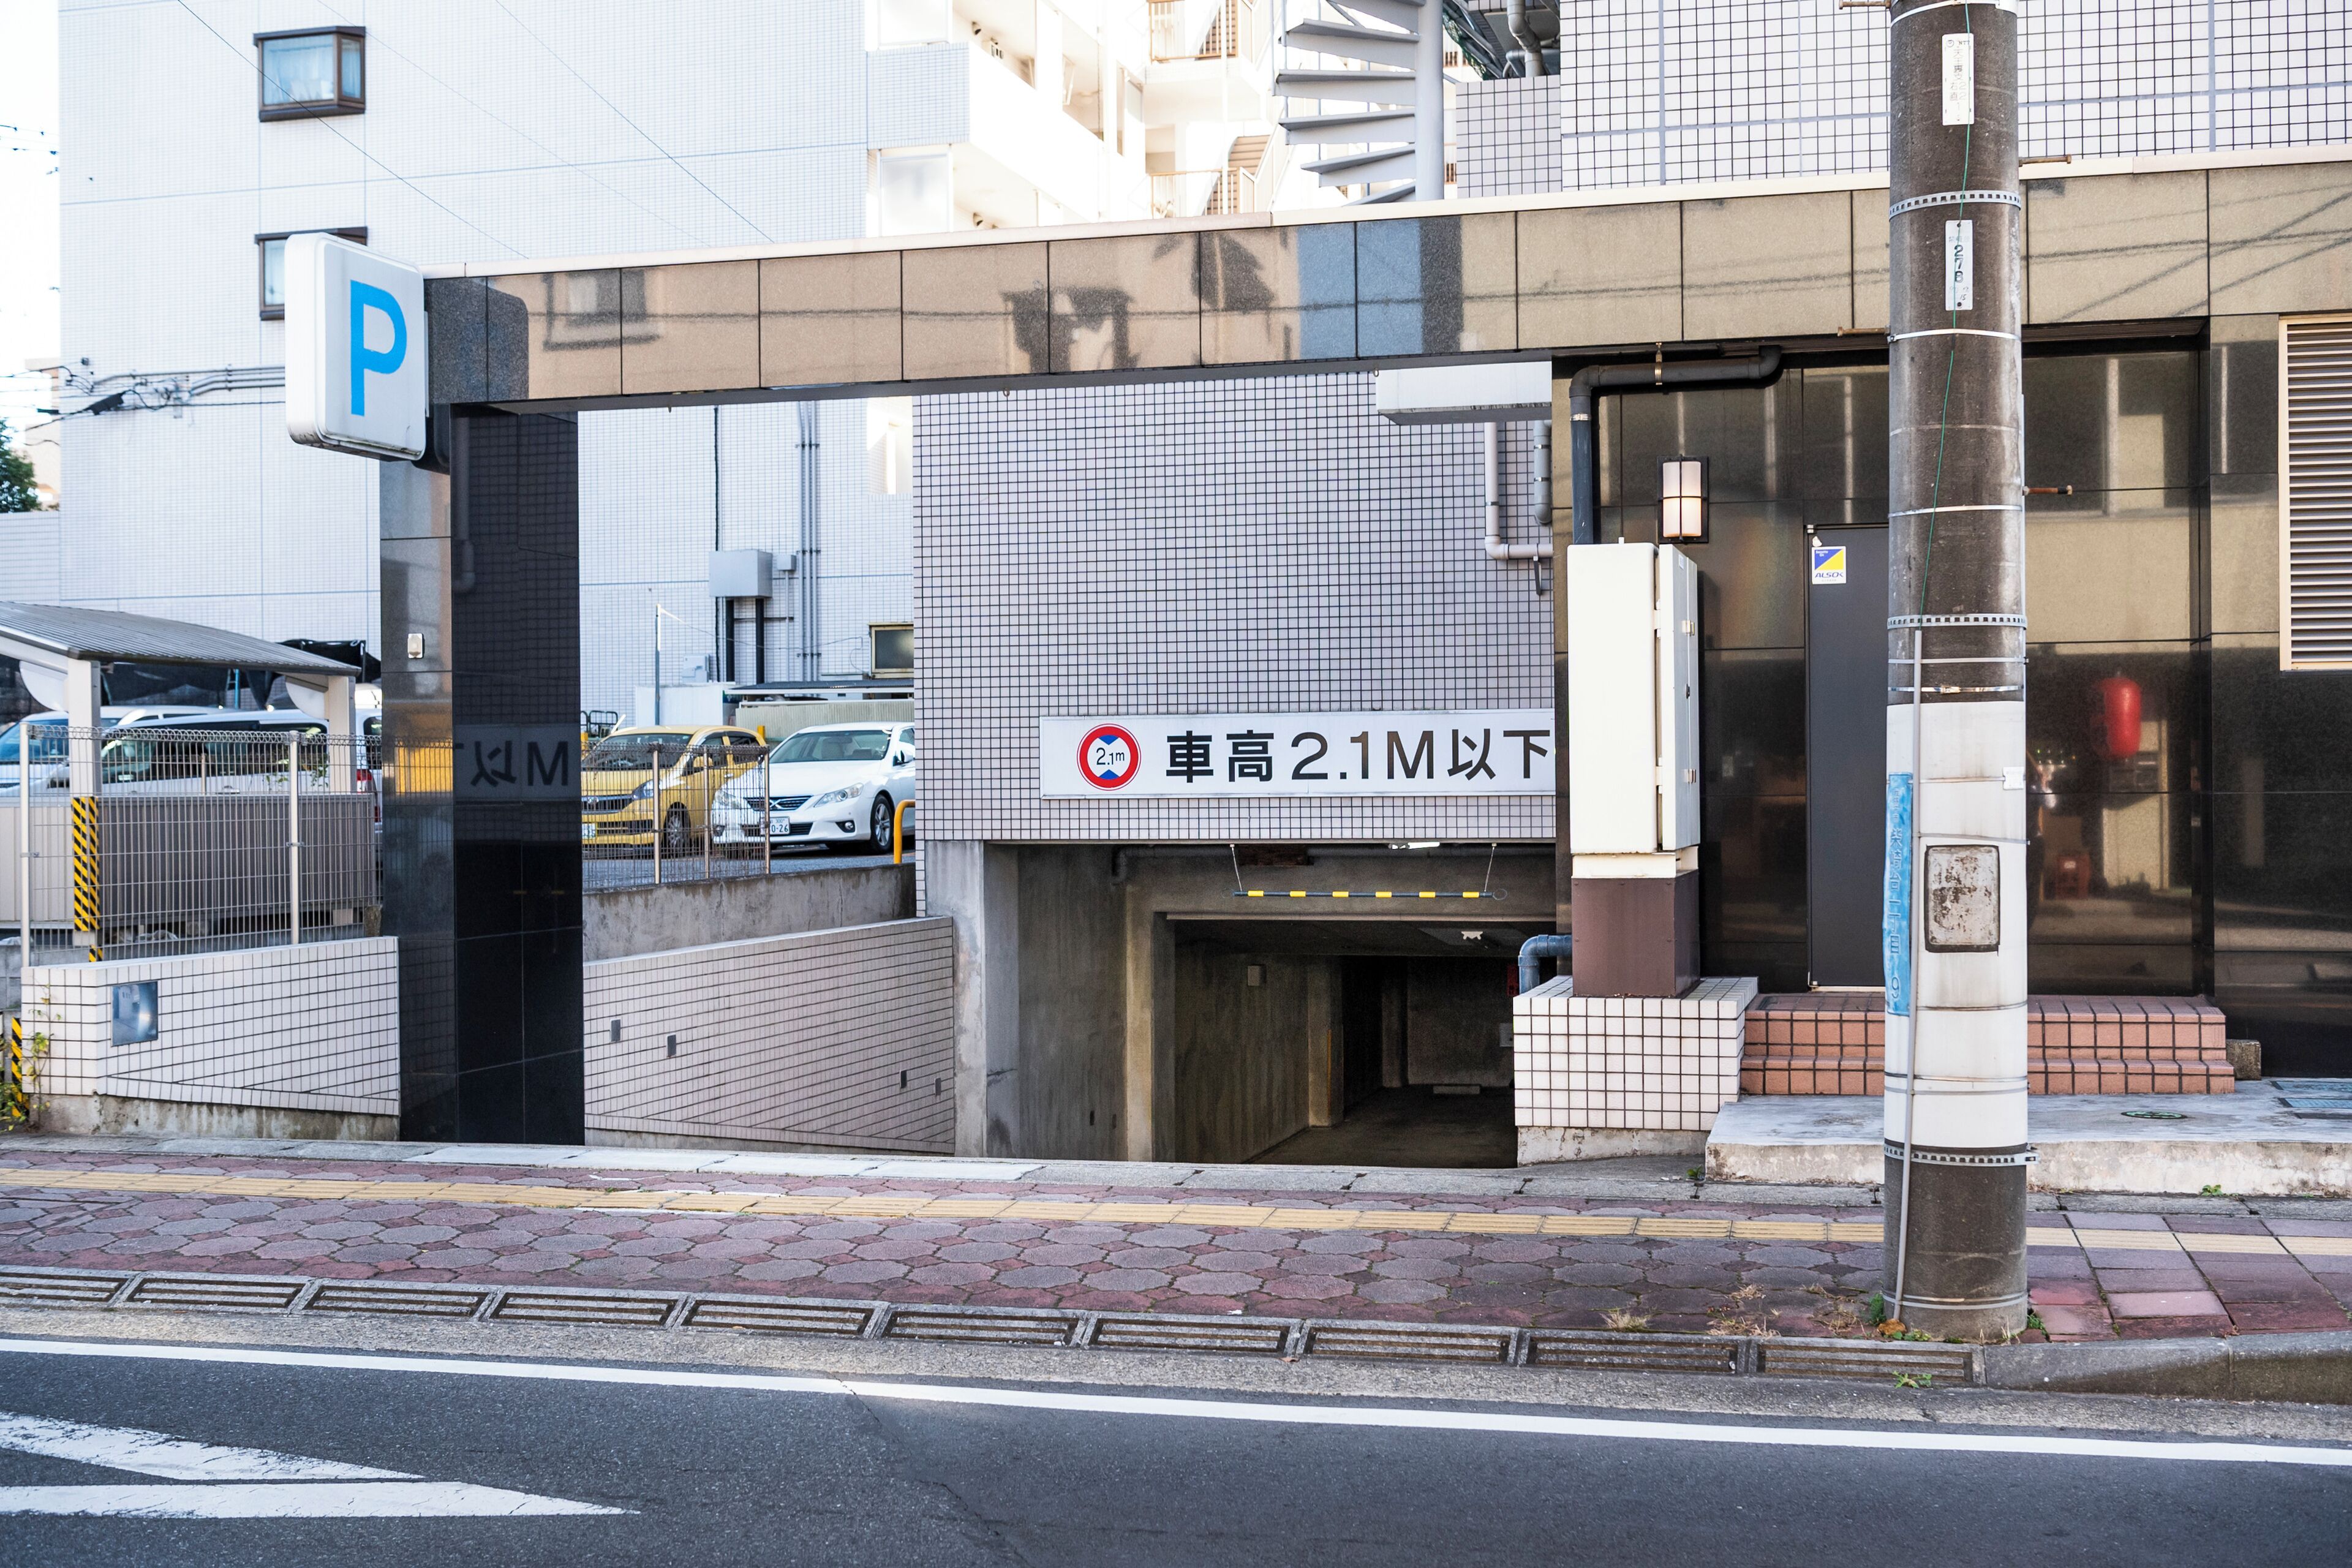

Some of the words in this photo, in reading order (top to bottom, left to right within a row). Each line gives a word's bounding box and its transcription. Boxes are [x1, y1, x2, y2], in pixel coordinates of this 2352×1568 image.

[350, 280, 407, 417] P
[1096, 747, 1125, 765] 2.1m
[1166, 728, 1551, 783] 車高2.1M以下
[771, 824, 789, 833] 0-26
[1891, 976, 1900, 999] 9
